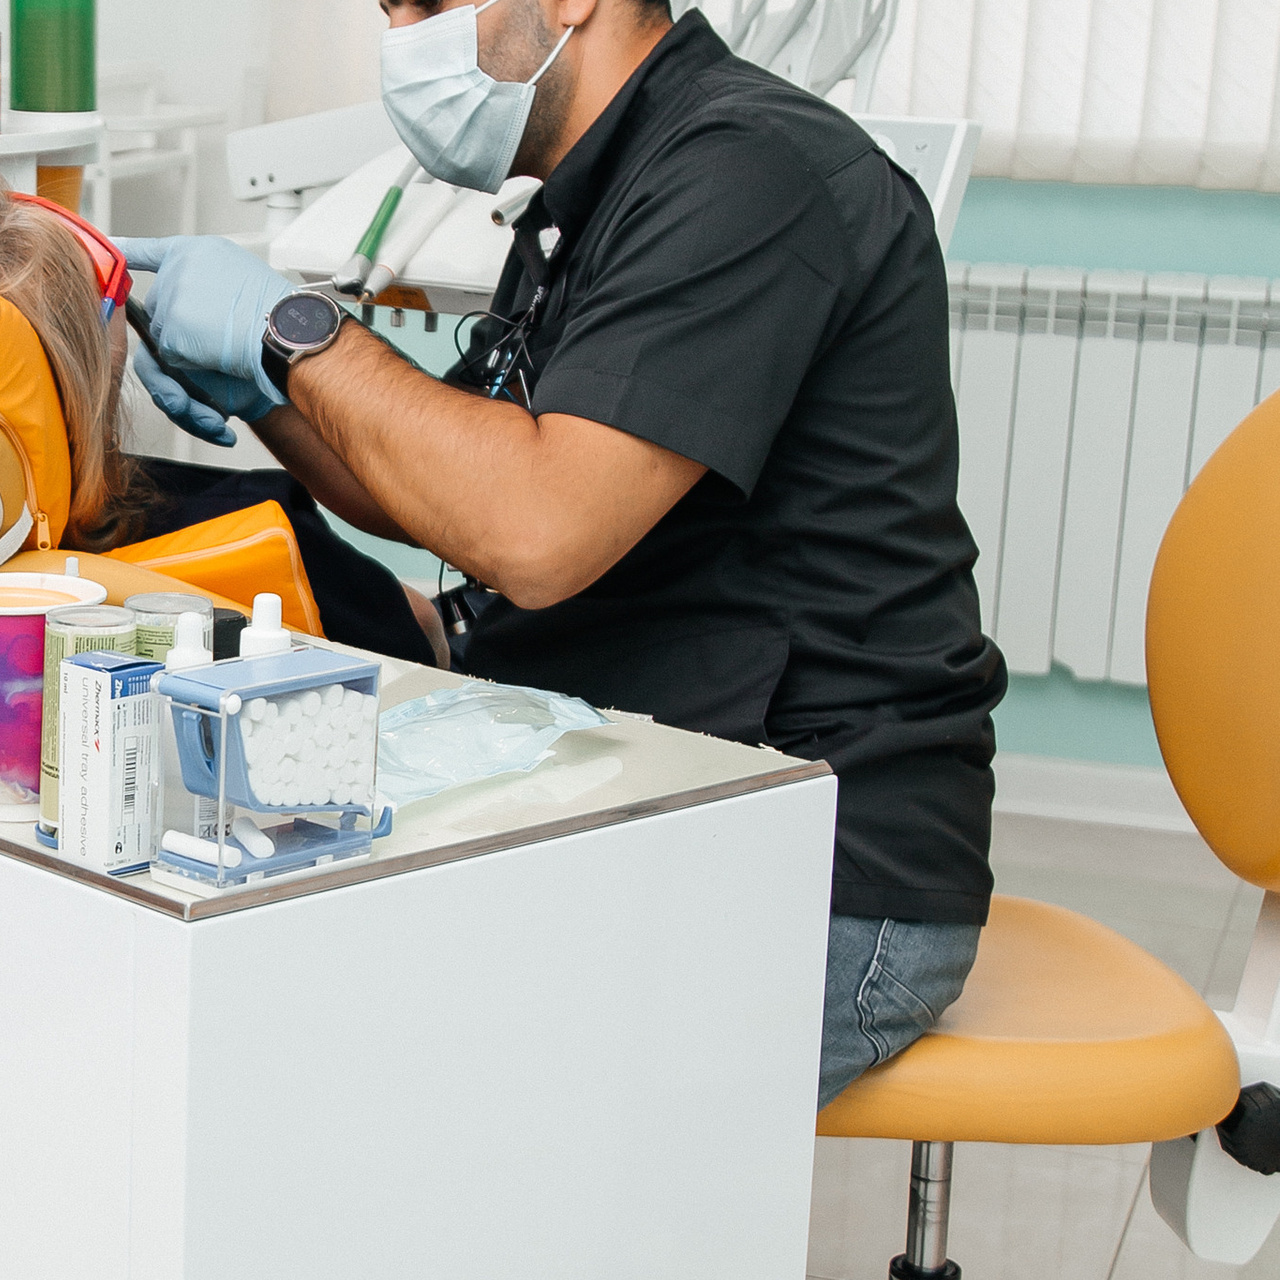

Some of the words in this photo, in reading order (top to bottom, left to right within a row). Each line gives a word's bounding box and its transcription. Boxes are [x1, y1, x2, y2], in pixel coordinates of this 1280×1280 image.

[81, 677, 89, 748] universal
[94, 680, 102, 737] Zhermack
[81, 753, 89, 782] tray
[81, 787, 89, 856] adhesive
